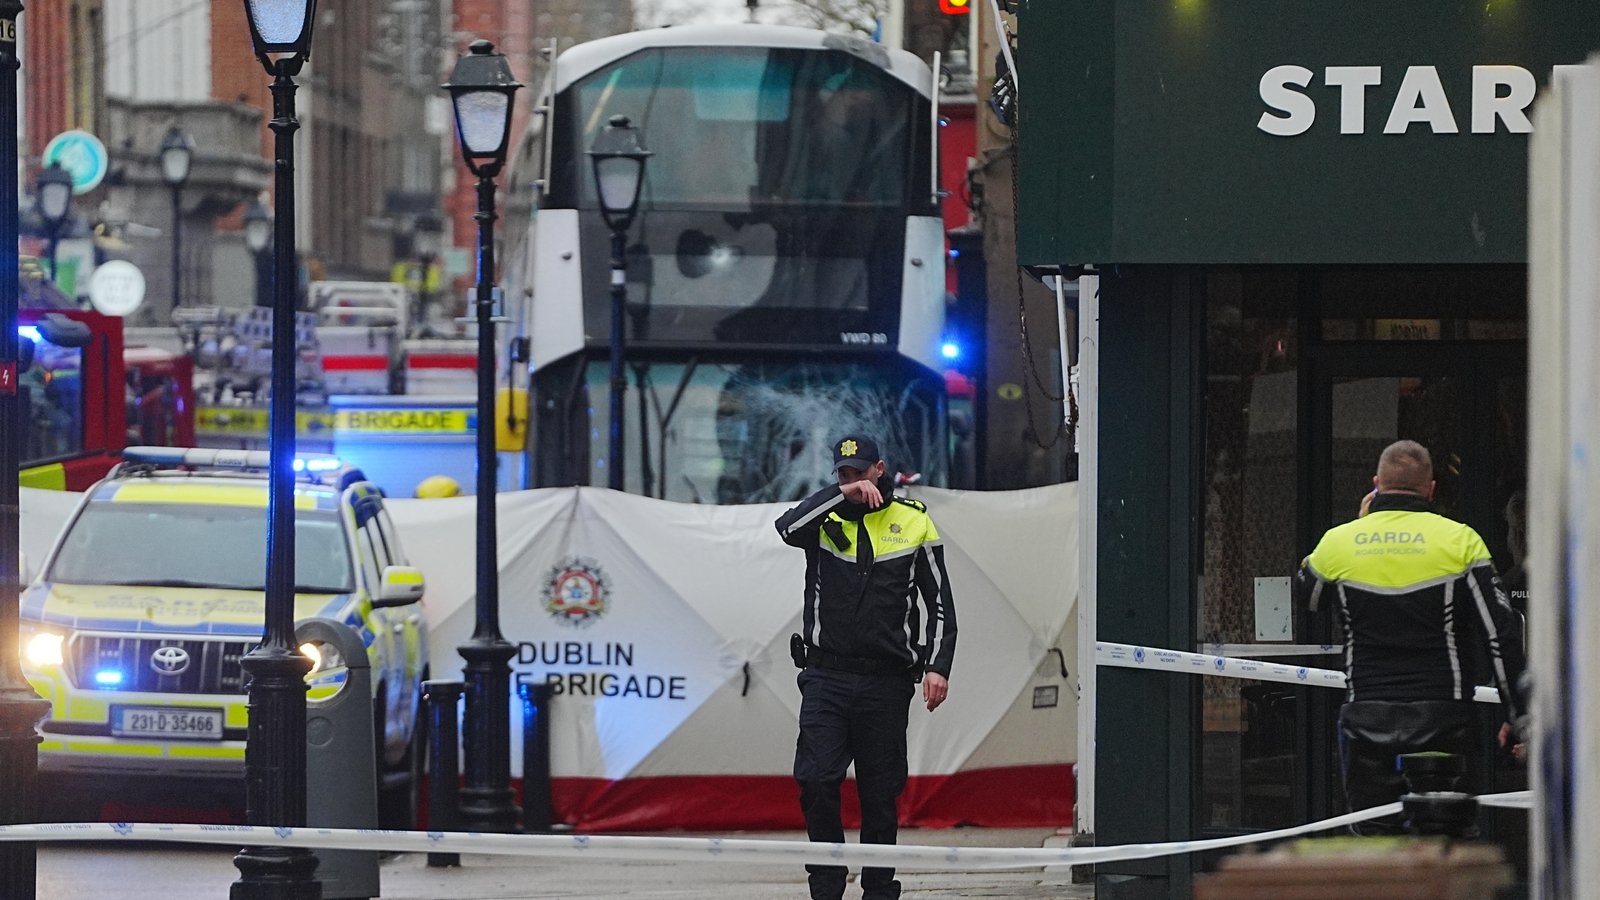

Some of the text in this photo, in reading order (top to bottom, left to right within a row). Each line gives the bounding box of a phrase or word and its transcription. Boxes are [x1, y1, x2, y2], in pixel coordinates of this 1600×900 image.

[349, 410, 451, 430] BRIGADE
[881, 535, 909, 544] GARDA
[1355, 531, 1425, 545] GARDA
[1511, 590, 1530, 599] PULL
[518, 641, 633, 666] DUBLIN
[546, 672, 687, 700] BRIGADE
[131, 713, 214, 732] 231-D-35466
